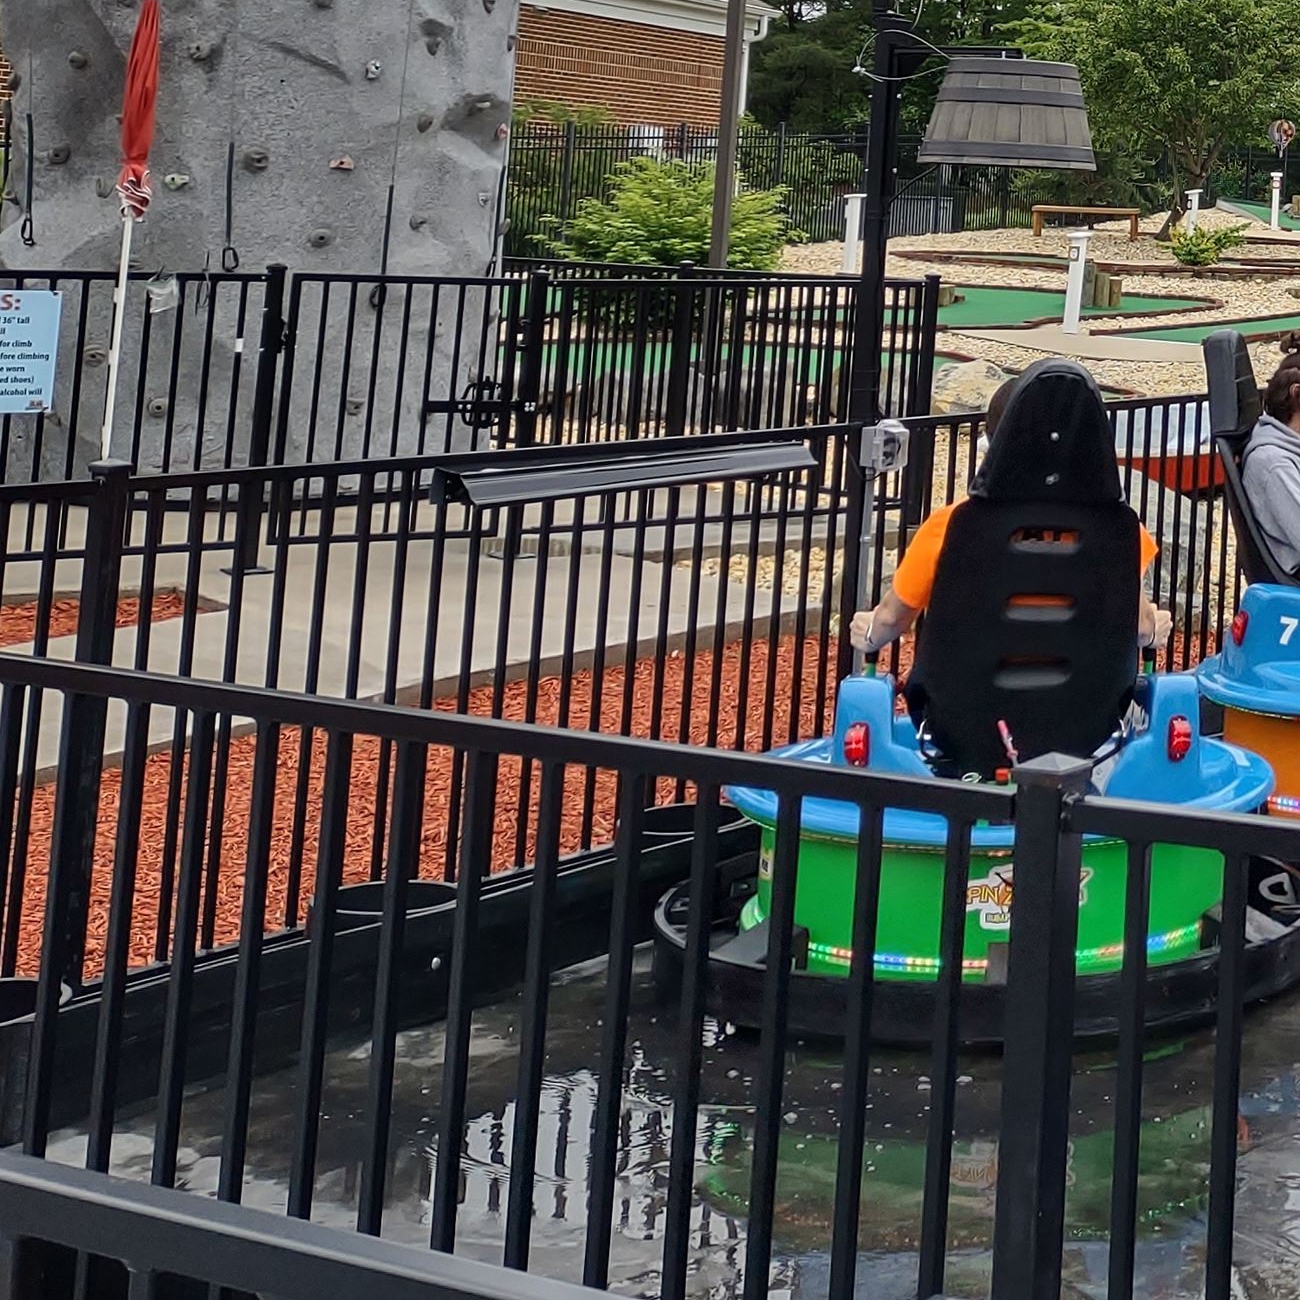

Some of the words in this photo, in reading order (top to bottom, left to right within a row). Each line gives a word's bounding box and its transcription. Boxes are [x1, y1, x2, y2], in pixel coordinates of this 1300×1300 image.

[17, 316, 30, 324] tall
[11, 340, 33, 348] climb
[17, 352, 50, 361] climbing
[10, 375, 35, 384] shoes)
[28, 387, 43, 396] will
[1279, 615, 1299, 645] 7
[966, 884, 1000, 906] PIN
